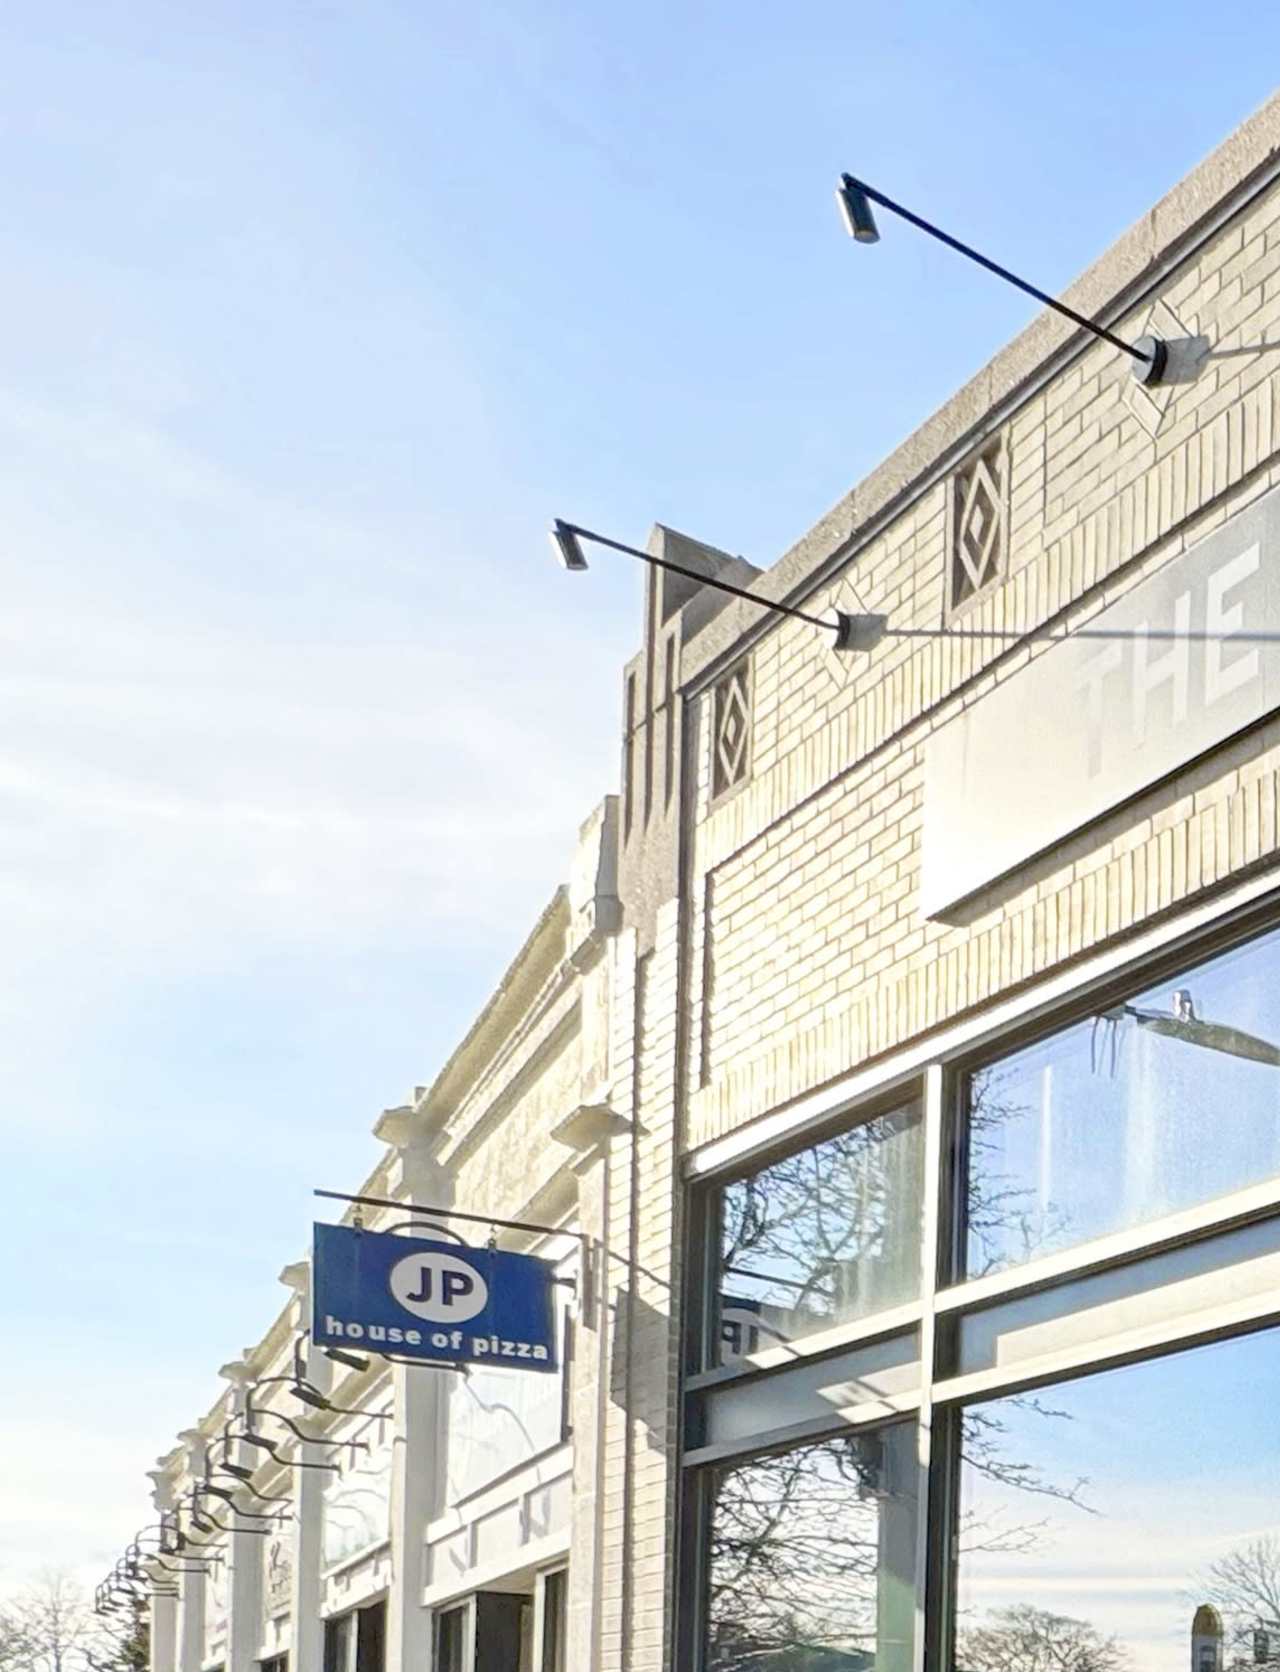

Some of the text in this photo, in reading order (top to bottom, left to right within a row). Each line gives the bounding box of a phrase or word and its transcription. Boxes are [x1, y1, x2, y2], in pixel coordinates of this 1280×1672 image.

[1074, 540, 1260, 779] THE
[406, 1267, 474, 1306] JP
[326, 1315, 548, 1360] house of pizza
